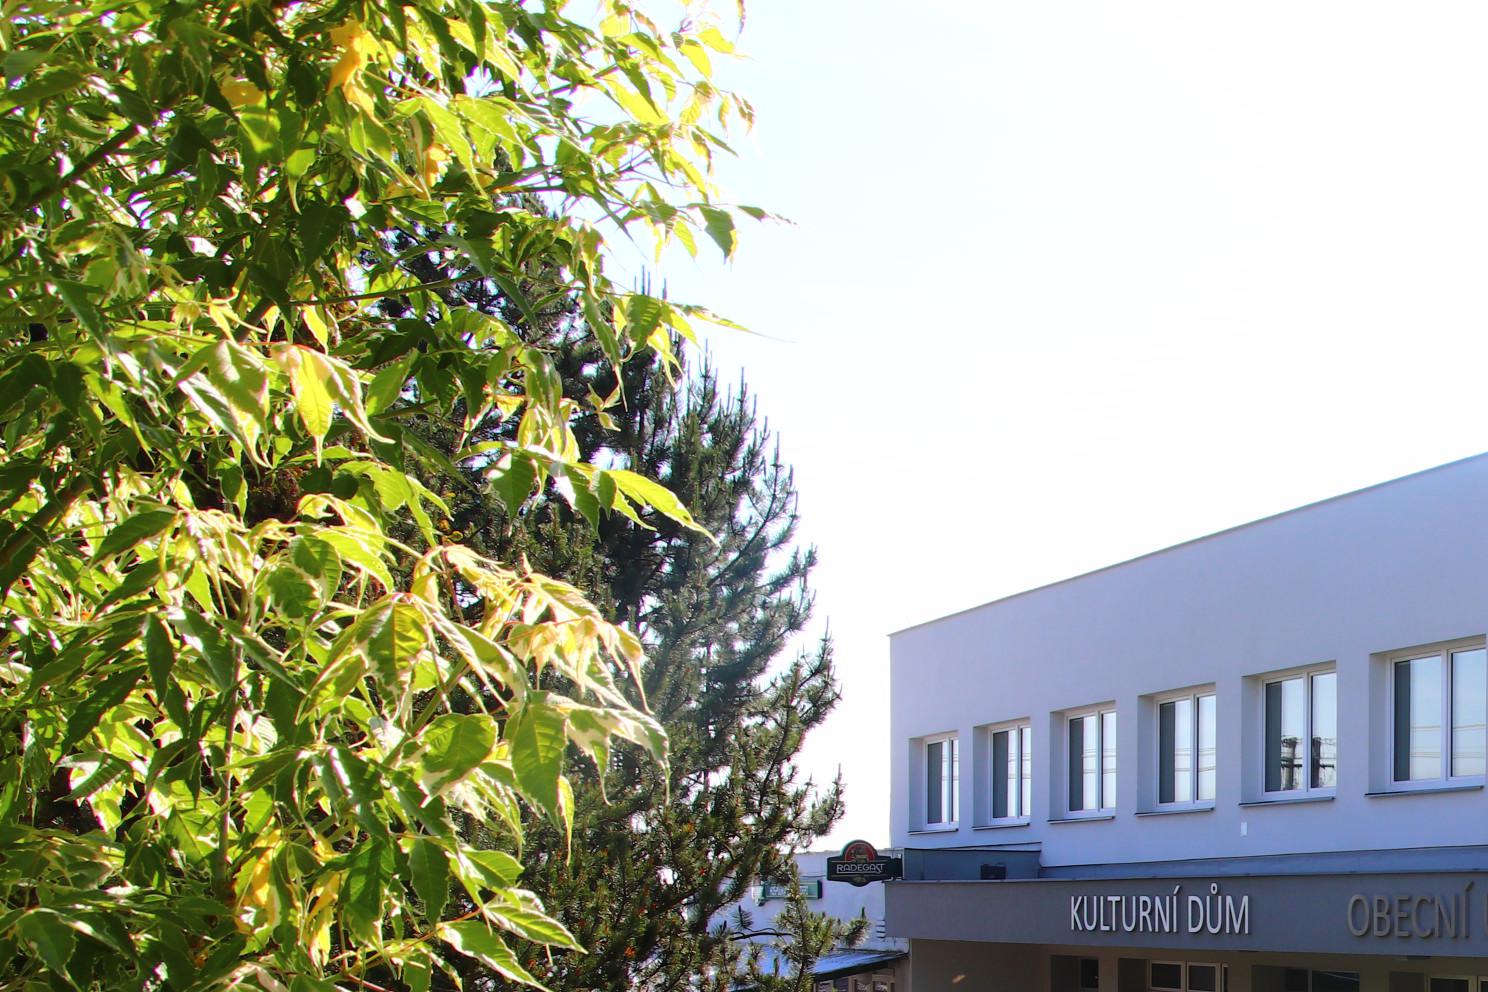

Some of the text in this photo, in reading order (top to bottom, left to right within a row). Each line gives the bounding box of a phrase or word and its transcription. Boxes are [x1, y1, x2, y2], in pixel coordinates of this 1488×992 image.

[836, 863, 885, 874] RADEGAST
[1070, 882, 1250, 935] KULTURNÍ DŮM
[1347, 880, 1475, 938] OBECNÍ
